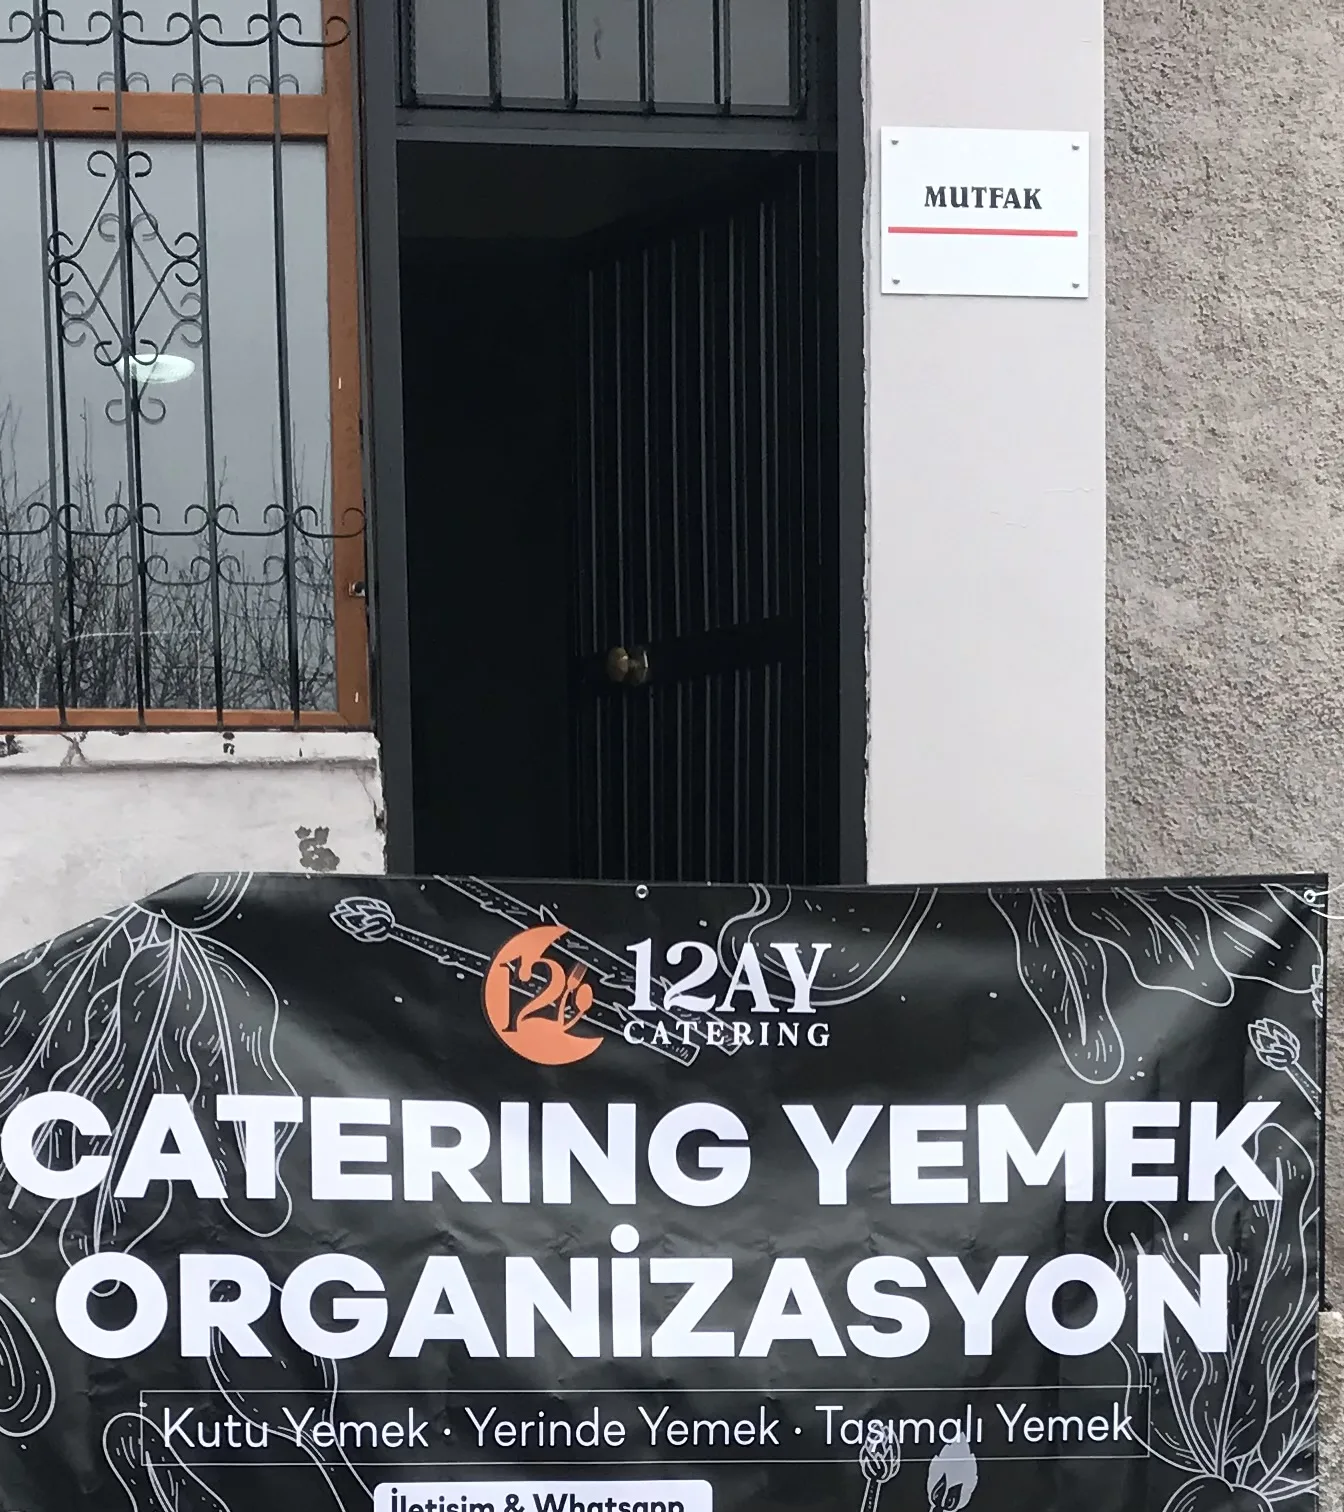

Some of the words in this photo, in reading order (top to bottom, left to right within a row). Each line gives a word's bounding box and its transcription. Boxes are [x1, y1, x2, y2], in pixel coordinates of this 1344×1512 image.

[924, 186, 1042, 210] MUTFAK
[626, 938, 832, 1014] 12AY
[623, 1021, 831, 1047] CATERING
[0, 1090, 752, 1206] CATERING
[782, 1101, 1282, 1205] YEMEK
[55, 1223, 1228, 1359] ORGANİZASYON
[161, 1408, 270, 1448] Kutu
[282, 1407, 429, 1448] Yemek
[465, 1408, 626, 1447] Yerinde
[638, 1406, 779, 1446] Yemek
[815, 1404, 983, 1452] Taşımalı
[996, 1402, 1133, 1443] Yemek
